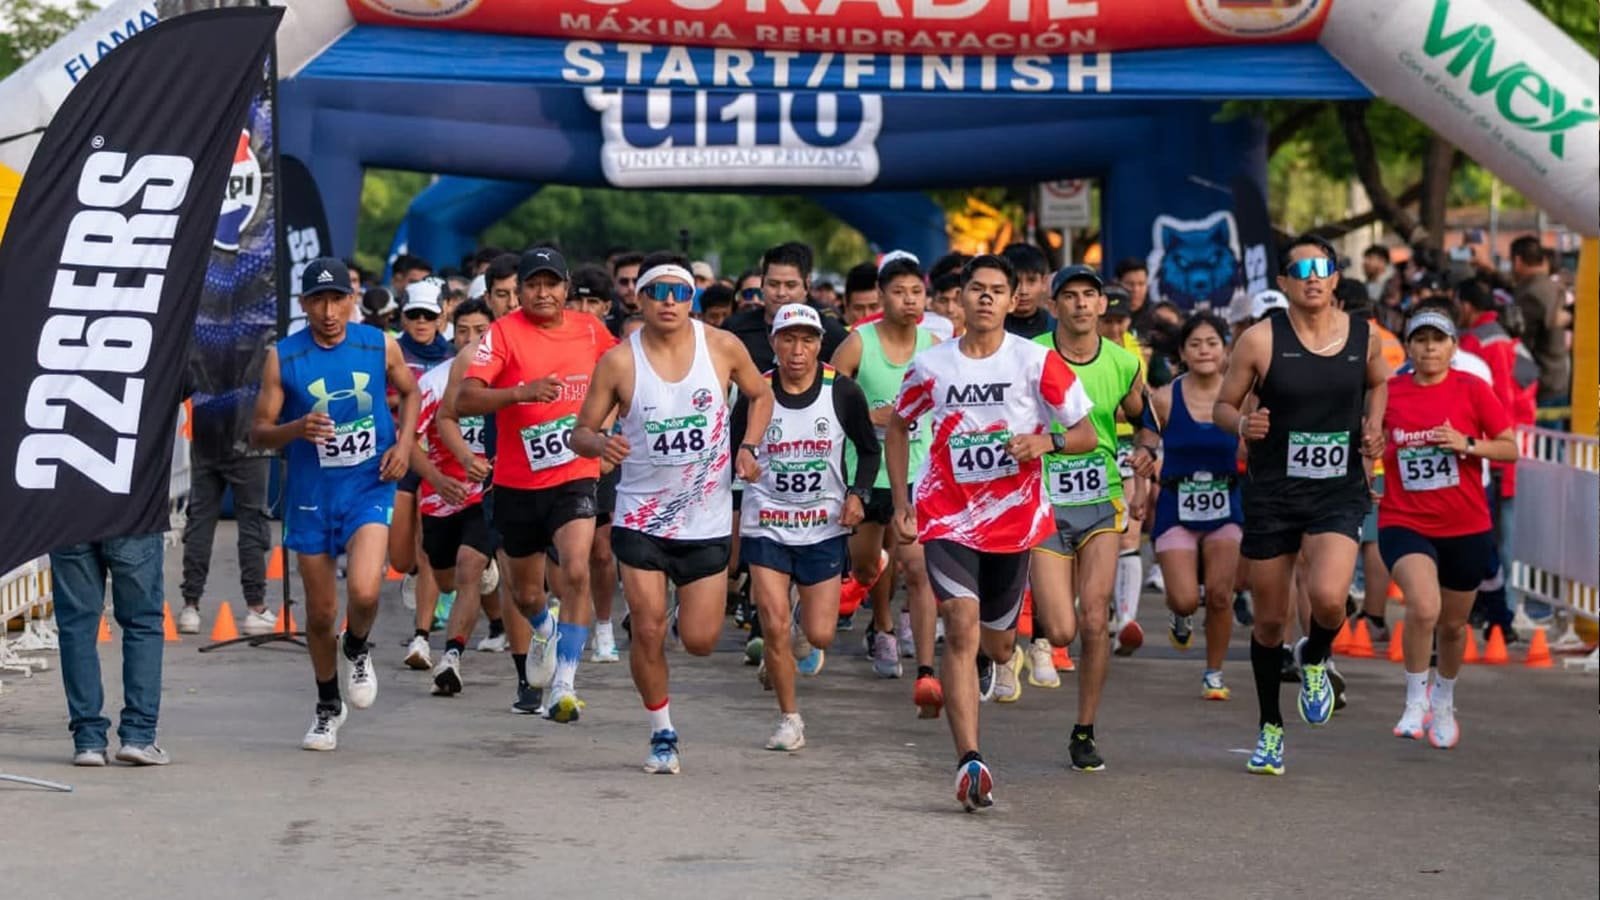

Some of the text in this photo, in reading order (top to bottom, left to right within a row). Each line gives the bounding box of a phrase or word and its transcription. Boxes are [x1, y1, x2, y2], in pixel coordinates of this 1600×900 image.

[559, 8, 736, 39] MÁXIMA
[755, 24, 1097, 49] REHIDRATACIÓN
[64, 8, 160, 84] FLAMA
[561, 40, 1113, 93] START/FINISH
[618, 150, 865, 169] UNIVERSIDAD PRIVADA
[14, 151, 194, 495] 226ERS
[325, 430, 371, 458] 542
[653, 429, 706, 456] 448
[957, 443, 1013, 472] 402
[1293, 446, 1345, 468] 480
[1407, 456, 1452, 480] 534
[775, 471, 822, 493] 582
[1058, 468, 1101, 494] 518
[1183, 491, 1226, 512] 490
[758, 509, 829, 529] BOLIVIA
